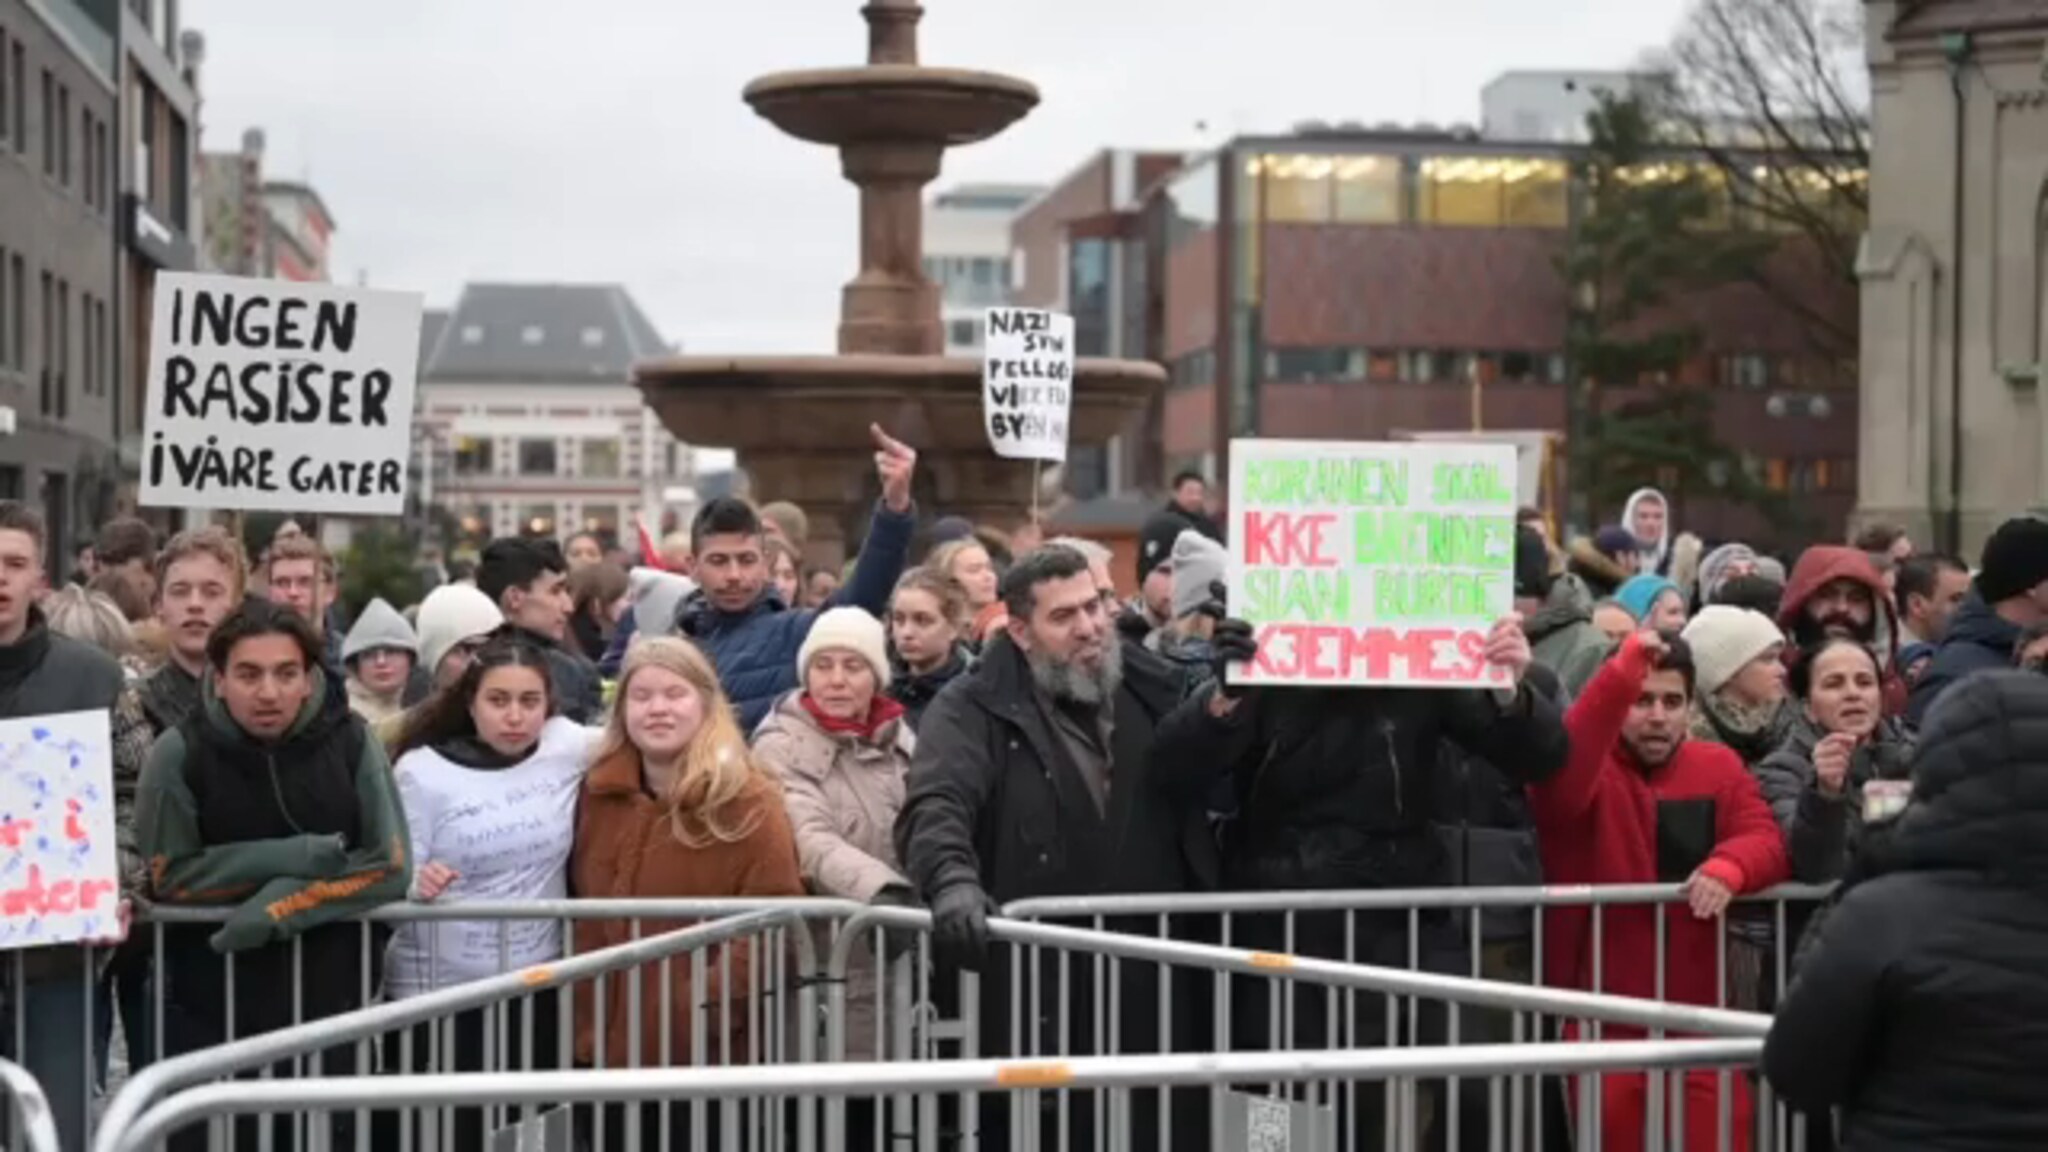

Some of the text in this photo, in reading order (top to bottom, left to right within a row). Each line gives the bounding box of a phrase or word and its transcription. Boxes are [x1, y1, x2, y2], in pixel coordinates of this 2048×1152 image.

[172, 288, 357, 352] INGEN
[989, 310, 1050, 336] NAZI
[169, 435, 279, 491] VÅRE
[288, 455, 401, 496] GATER
[1244, 458, 1511, 506] KORANEN SKAL
[1244, 511, 1338, 567] IKKE
[1242, 568, 1504, 622] SIAN BURDE
